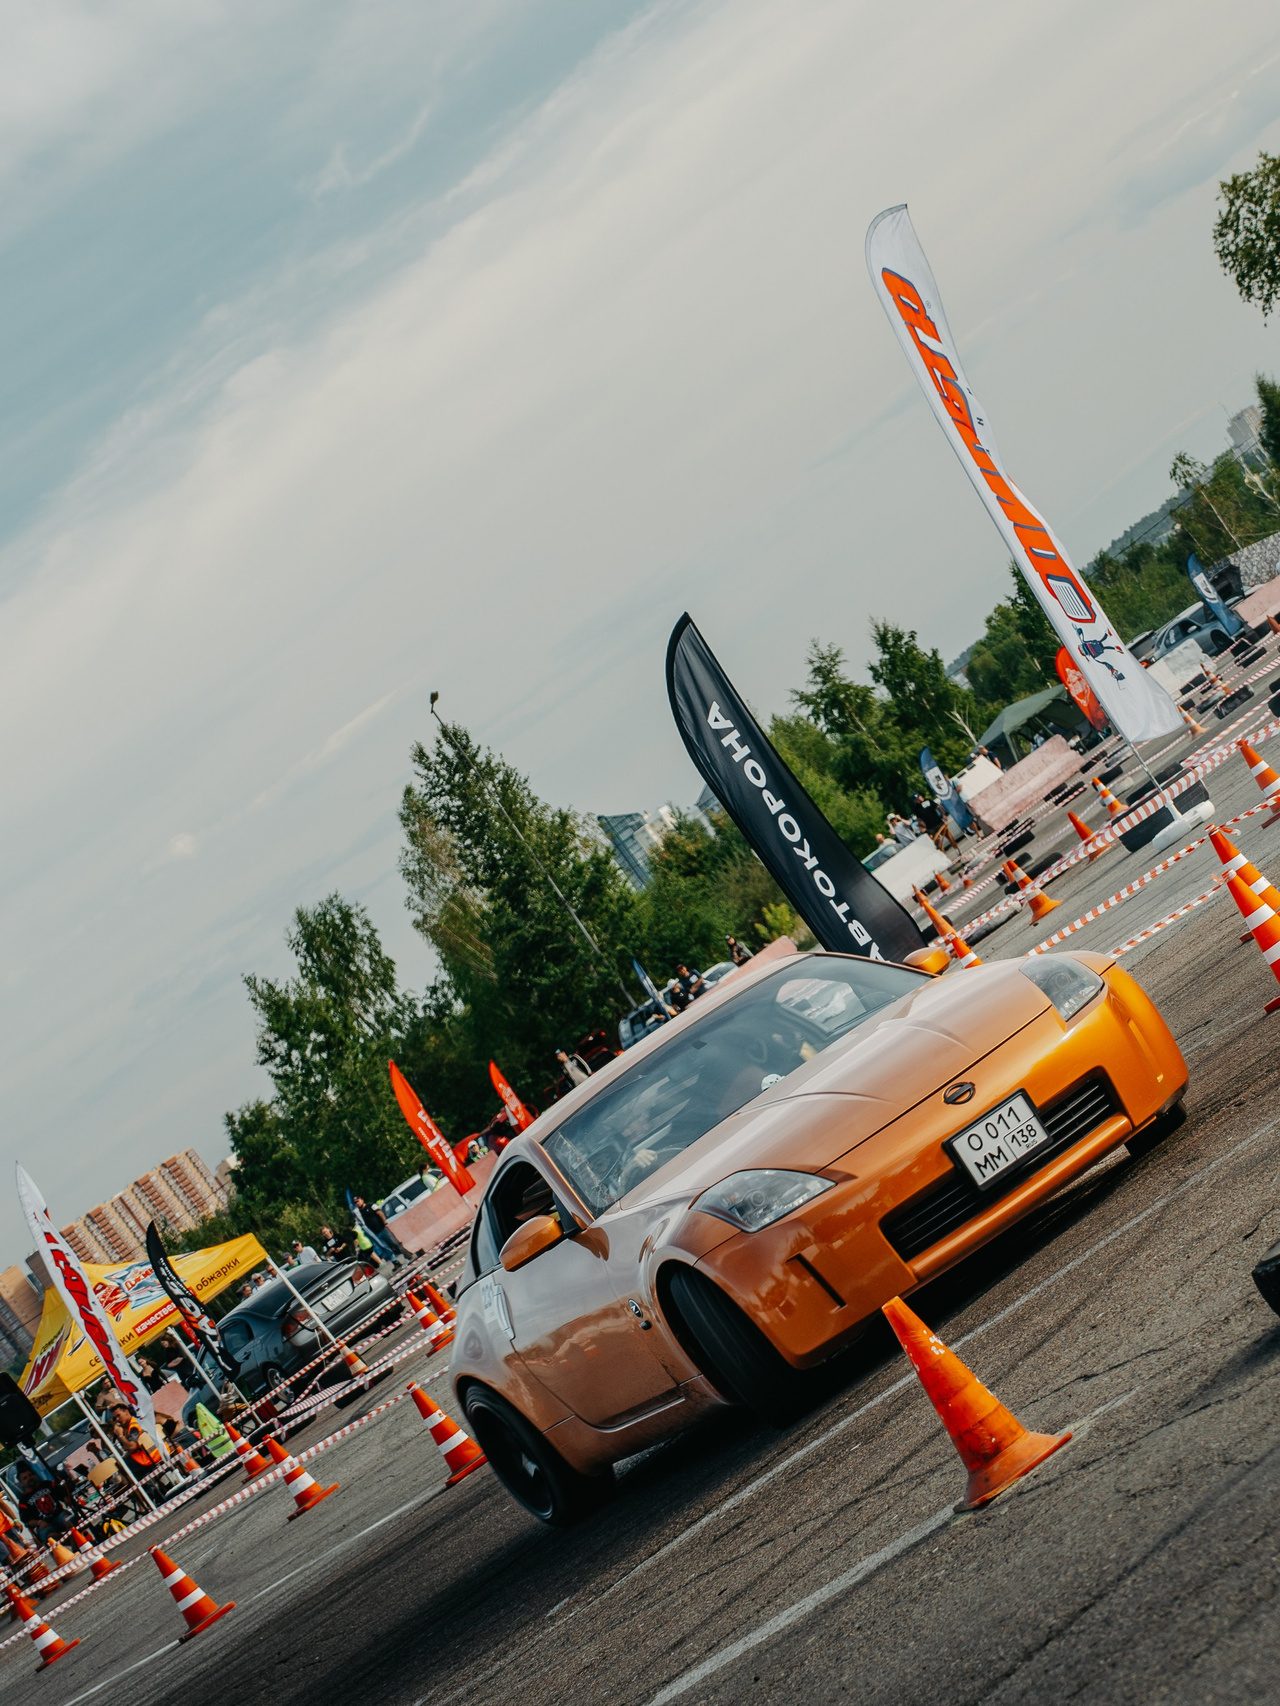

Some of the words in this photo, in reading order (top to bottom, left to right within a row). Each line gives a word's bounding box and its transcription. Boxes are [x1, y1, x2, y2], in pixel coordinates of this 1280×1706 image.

[707, 700, 892, 963] АВТОКОРОНА
[974, 1146, 1009, 1179] ММ
[1011, 1124, 1037, 1148] 138
[196, 1258, 240, 1292] обжарки
